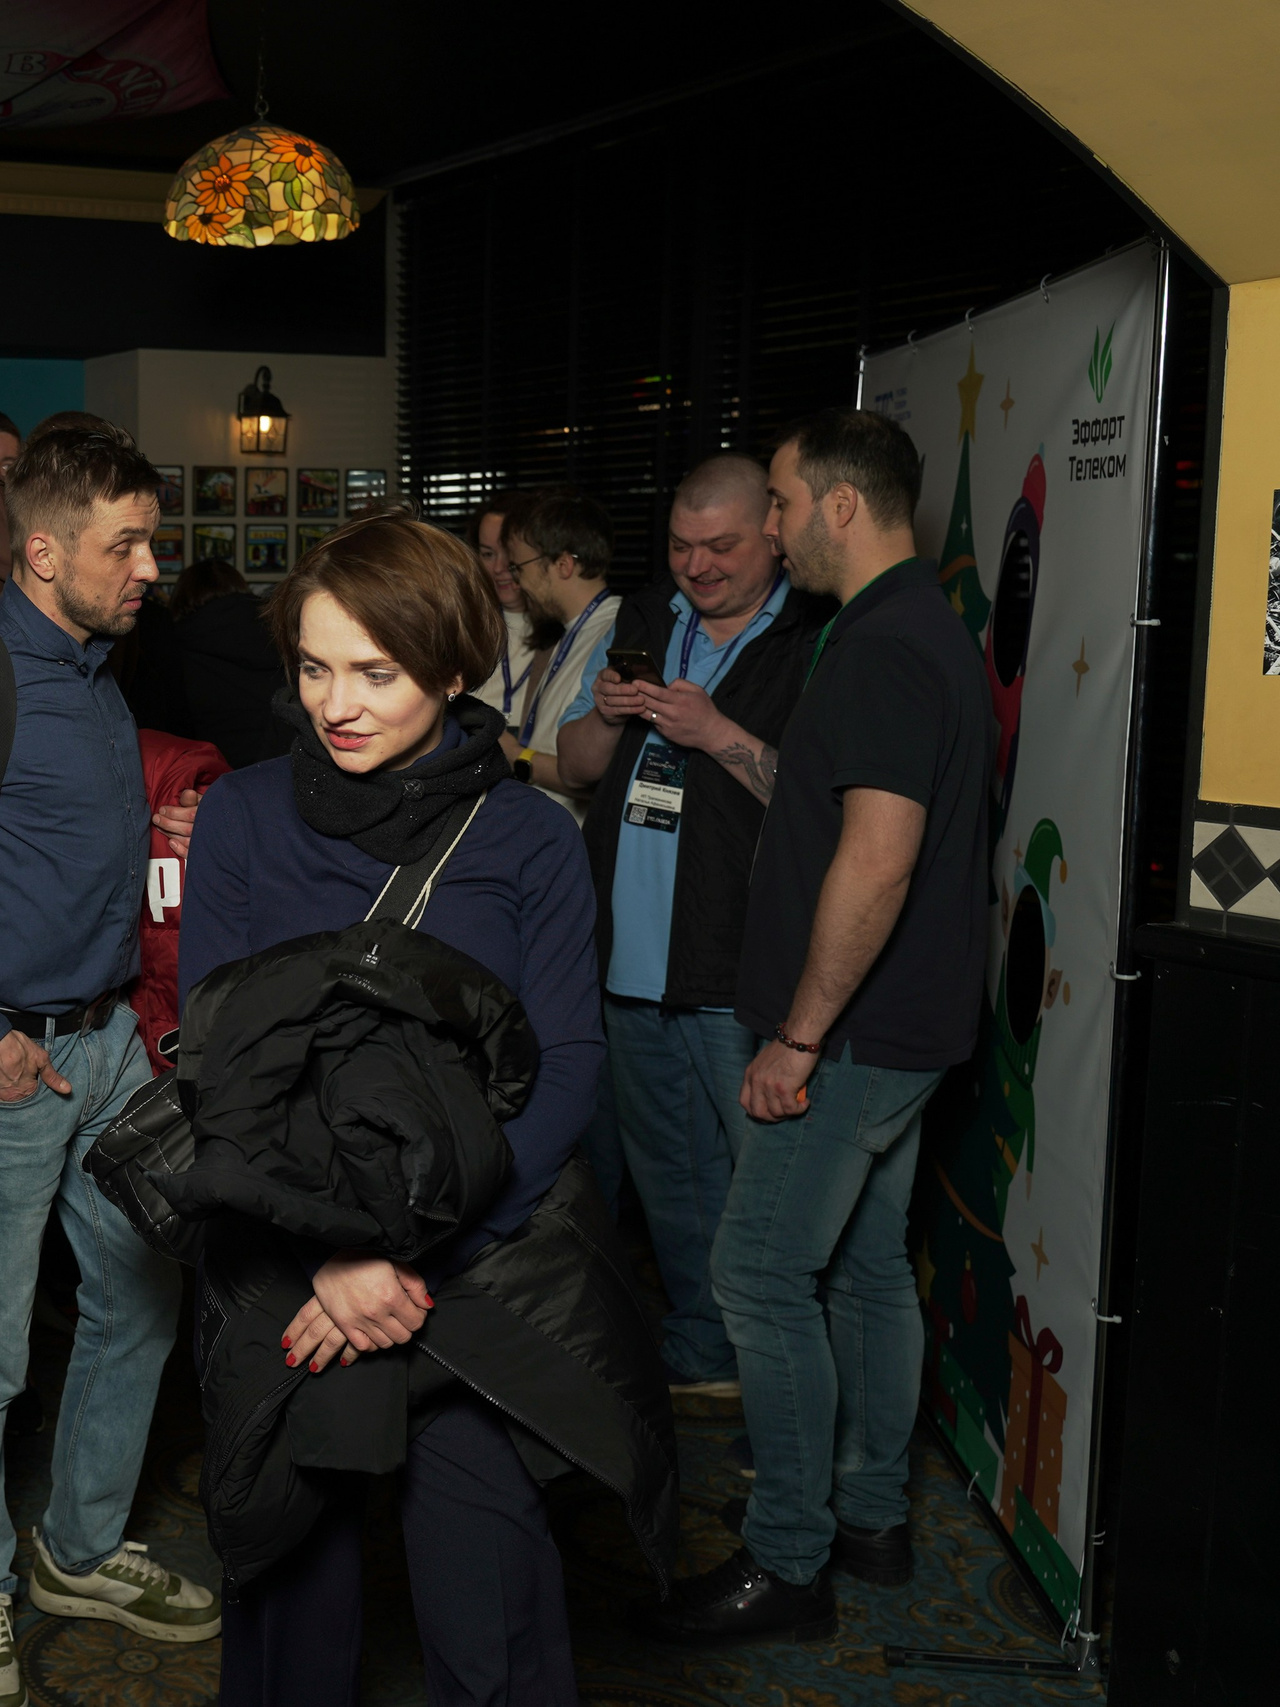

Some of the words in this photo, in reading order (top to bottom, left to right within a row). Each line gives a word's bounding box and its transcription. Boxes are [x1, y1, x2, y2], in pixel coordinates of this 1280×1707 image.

[1072, 415, 1125, 447] Эффорт
[1069, 453, 1126, 482] Телеком
[147, 857, 180, 922] P
